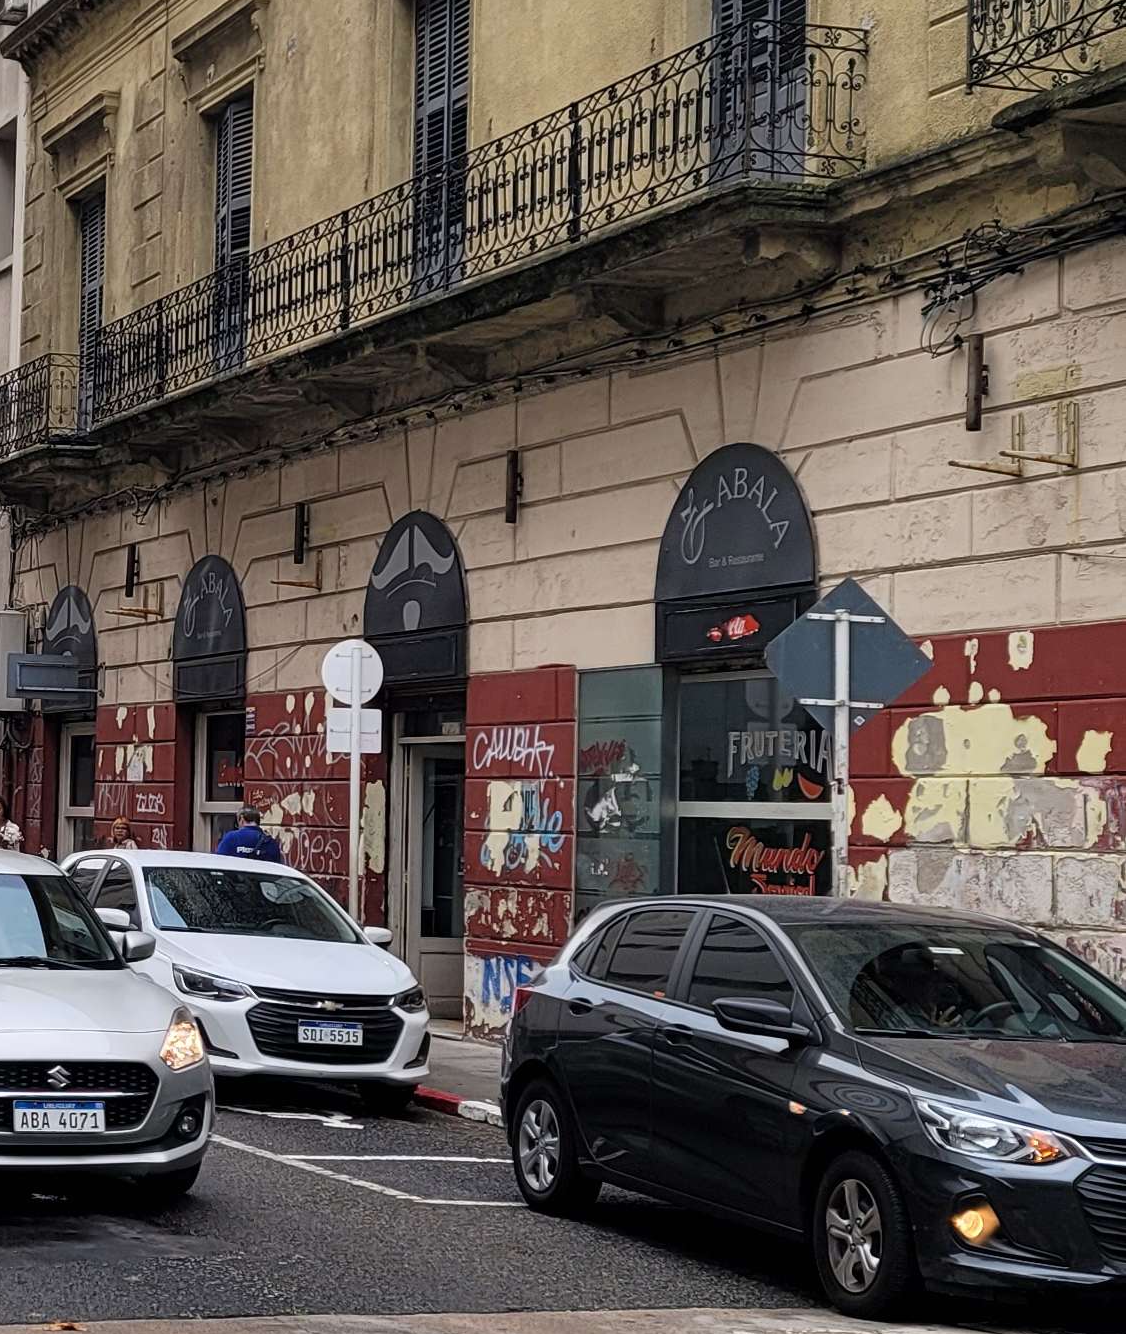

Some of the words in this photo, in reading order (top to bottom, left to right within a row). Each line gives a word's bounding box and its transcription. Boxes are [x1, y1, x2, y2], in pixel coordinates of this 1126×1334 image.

[726, 826, 825, 875] Mundo
[330, 1030, 359, 1043] 5515
[21, 1112, 50, 1129] ABA
[59, 1112, 99, 1129] 4071
